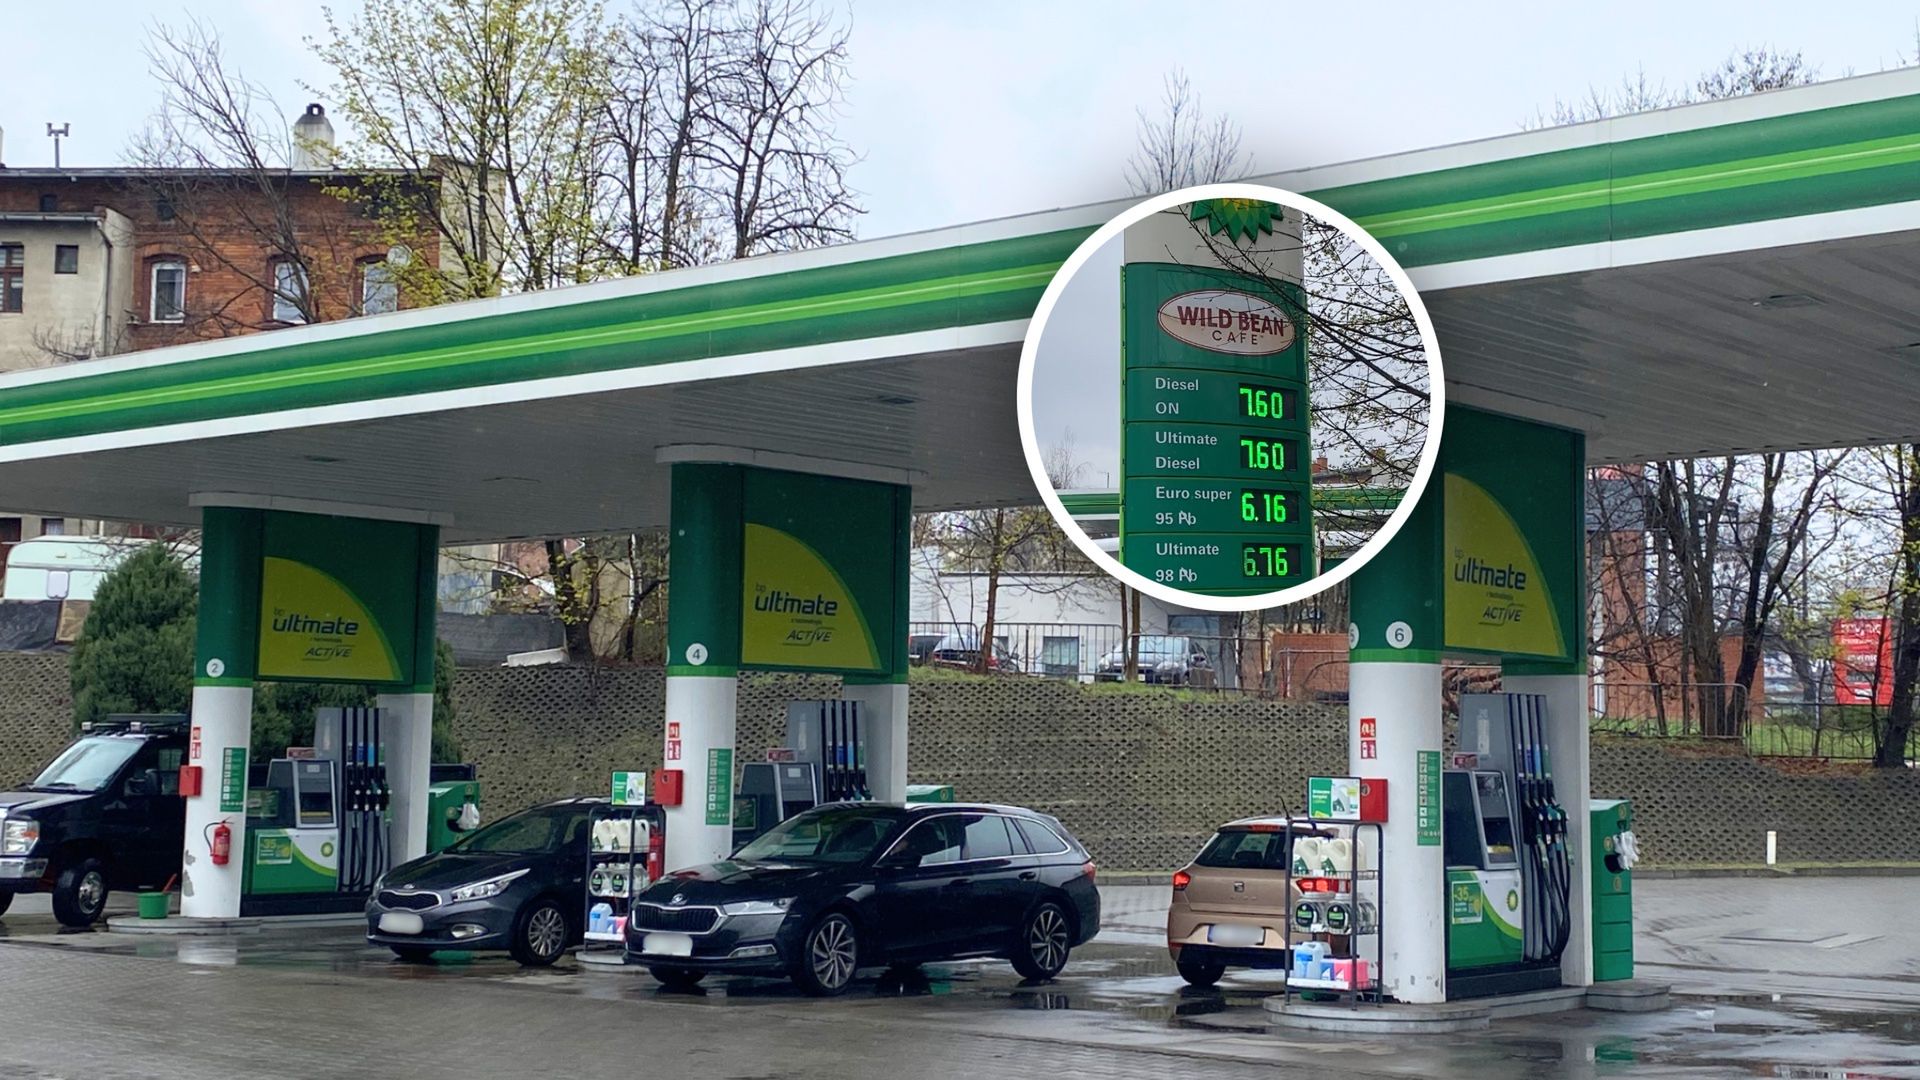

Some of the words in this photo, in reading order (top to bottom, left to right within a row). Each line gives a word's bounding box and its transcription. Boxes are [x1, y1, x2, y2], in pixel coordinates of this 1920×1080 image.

[1177, 306, 1232, 329] WILD
[1238, 311, 1284, 337] BEAN
[1212, 330, 1258, 345] CAFE
[1155, 378, 1199, 391] Diesel
[1155, 402, 1179, 414] ON
[1240, 388, 1283, 419] 7.60
[1155, 431, 1218, 445] Ultimate
[1240, 440, 1284, 470] 7.60
[1155, 457, 1200, 470] Diesel
[1156, 487, 1190, 499] Euro
[1195, 489, 1232, 502] super
[1242, 493, 1286, 523] 6.16
[1155, 513, 1174, 525] 95
[1156, 543, 1219, 556] Ultimate
[1244, 547, 1288, 576] 6.76
[1155, 570, 1174, 582] 98
[1455, 557, 1526, 590] ultimate
[755, 591, 837, 616] ultimate
[1482, 606, 1523, 621] ACTIVE
[273, 614, 358, 635] ultimate
[787, 629, 832, 641] ACTIVE
[1395, 628, 1404, 642] 6
[305, 647, 351, 657] ACTIVE
[692, 649, 700, 660] 4
[211, 663, 219, 673] 2
